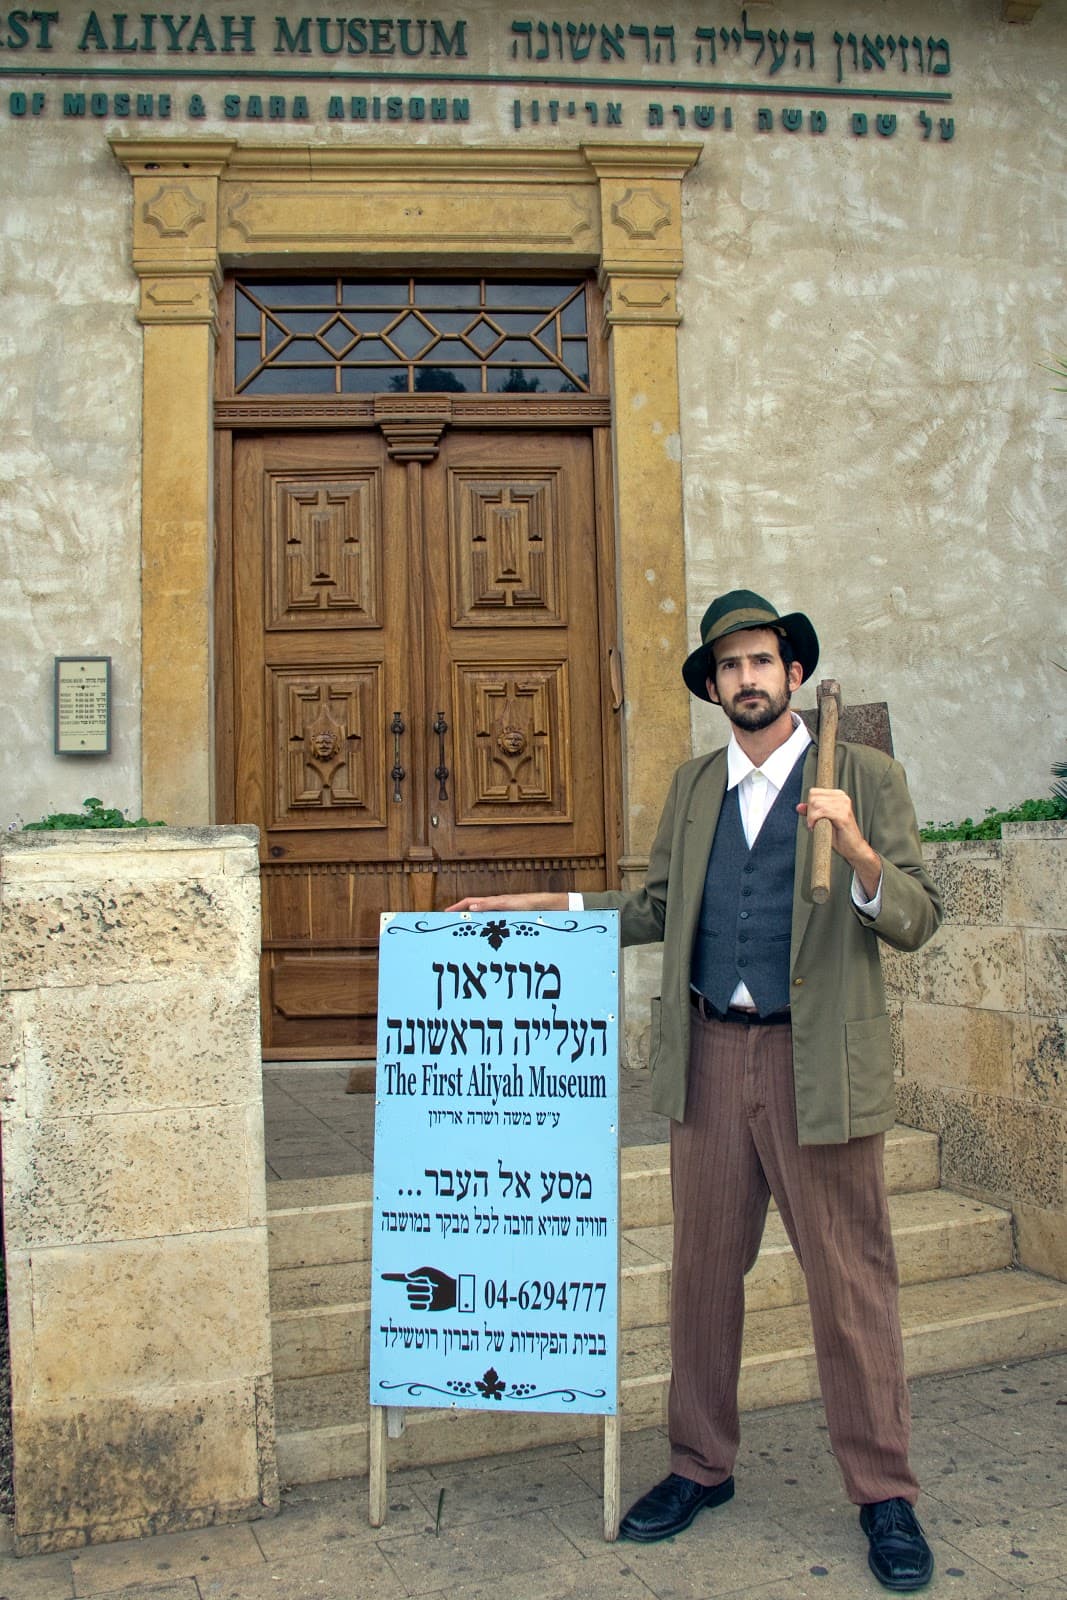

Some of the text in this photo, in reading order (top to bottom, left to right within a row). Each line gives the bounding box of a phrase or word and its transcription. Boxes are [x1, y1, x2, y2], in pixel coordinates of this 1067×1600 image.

[0, 10, 468, 57] ST ALIYAH MUSEUM
[511, 9, 951, 83] מוזיאון העלייה הראשונה
[9, 92, 470, 121] OF MOSHE & SARA ARISOHN
[513, 99, 955, 141] על שם משה ושרה אריזון
[432, 961, 561, 1010] מוזיאון
[386, 1003, 608, 1063] העלייה הראשונה
[384, 1062, 607, 1106] The First Aliyah Museum
[428, 1109, 463, 1128] אריזון
[466, 1110, 499, 1126] ושרה
[503, 1111, 532, 1126] משה
[497, 1159, 531, 1199] אל
[540, 1169, 592, 1204] מסע
[381, 1205, 607, 1240] חוויה שהיא חובה לכל מבקר במושבה
[484, 1279, 607, 1313] 04-6294777
[380, 1317, 607, 1360] בבית הפקידות של הברון רוטשילד
